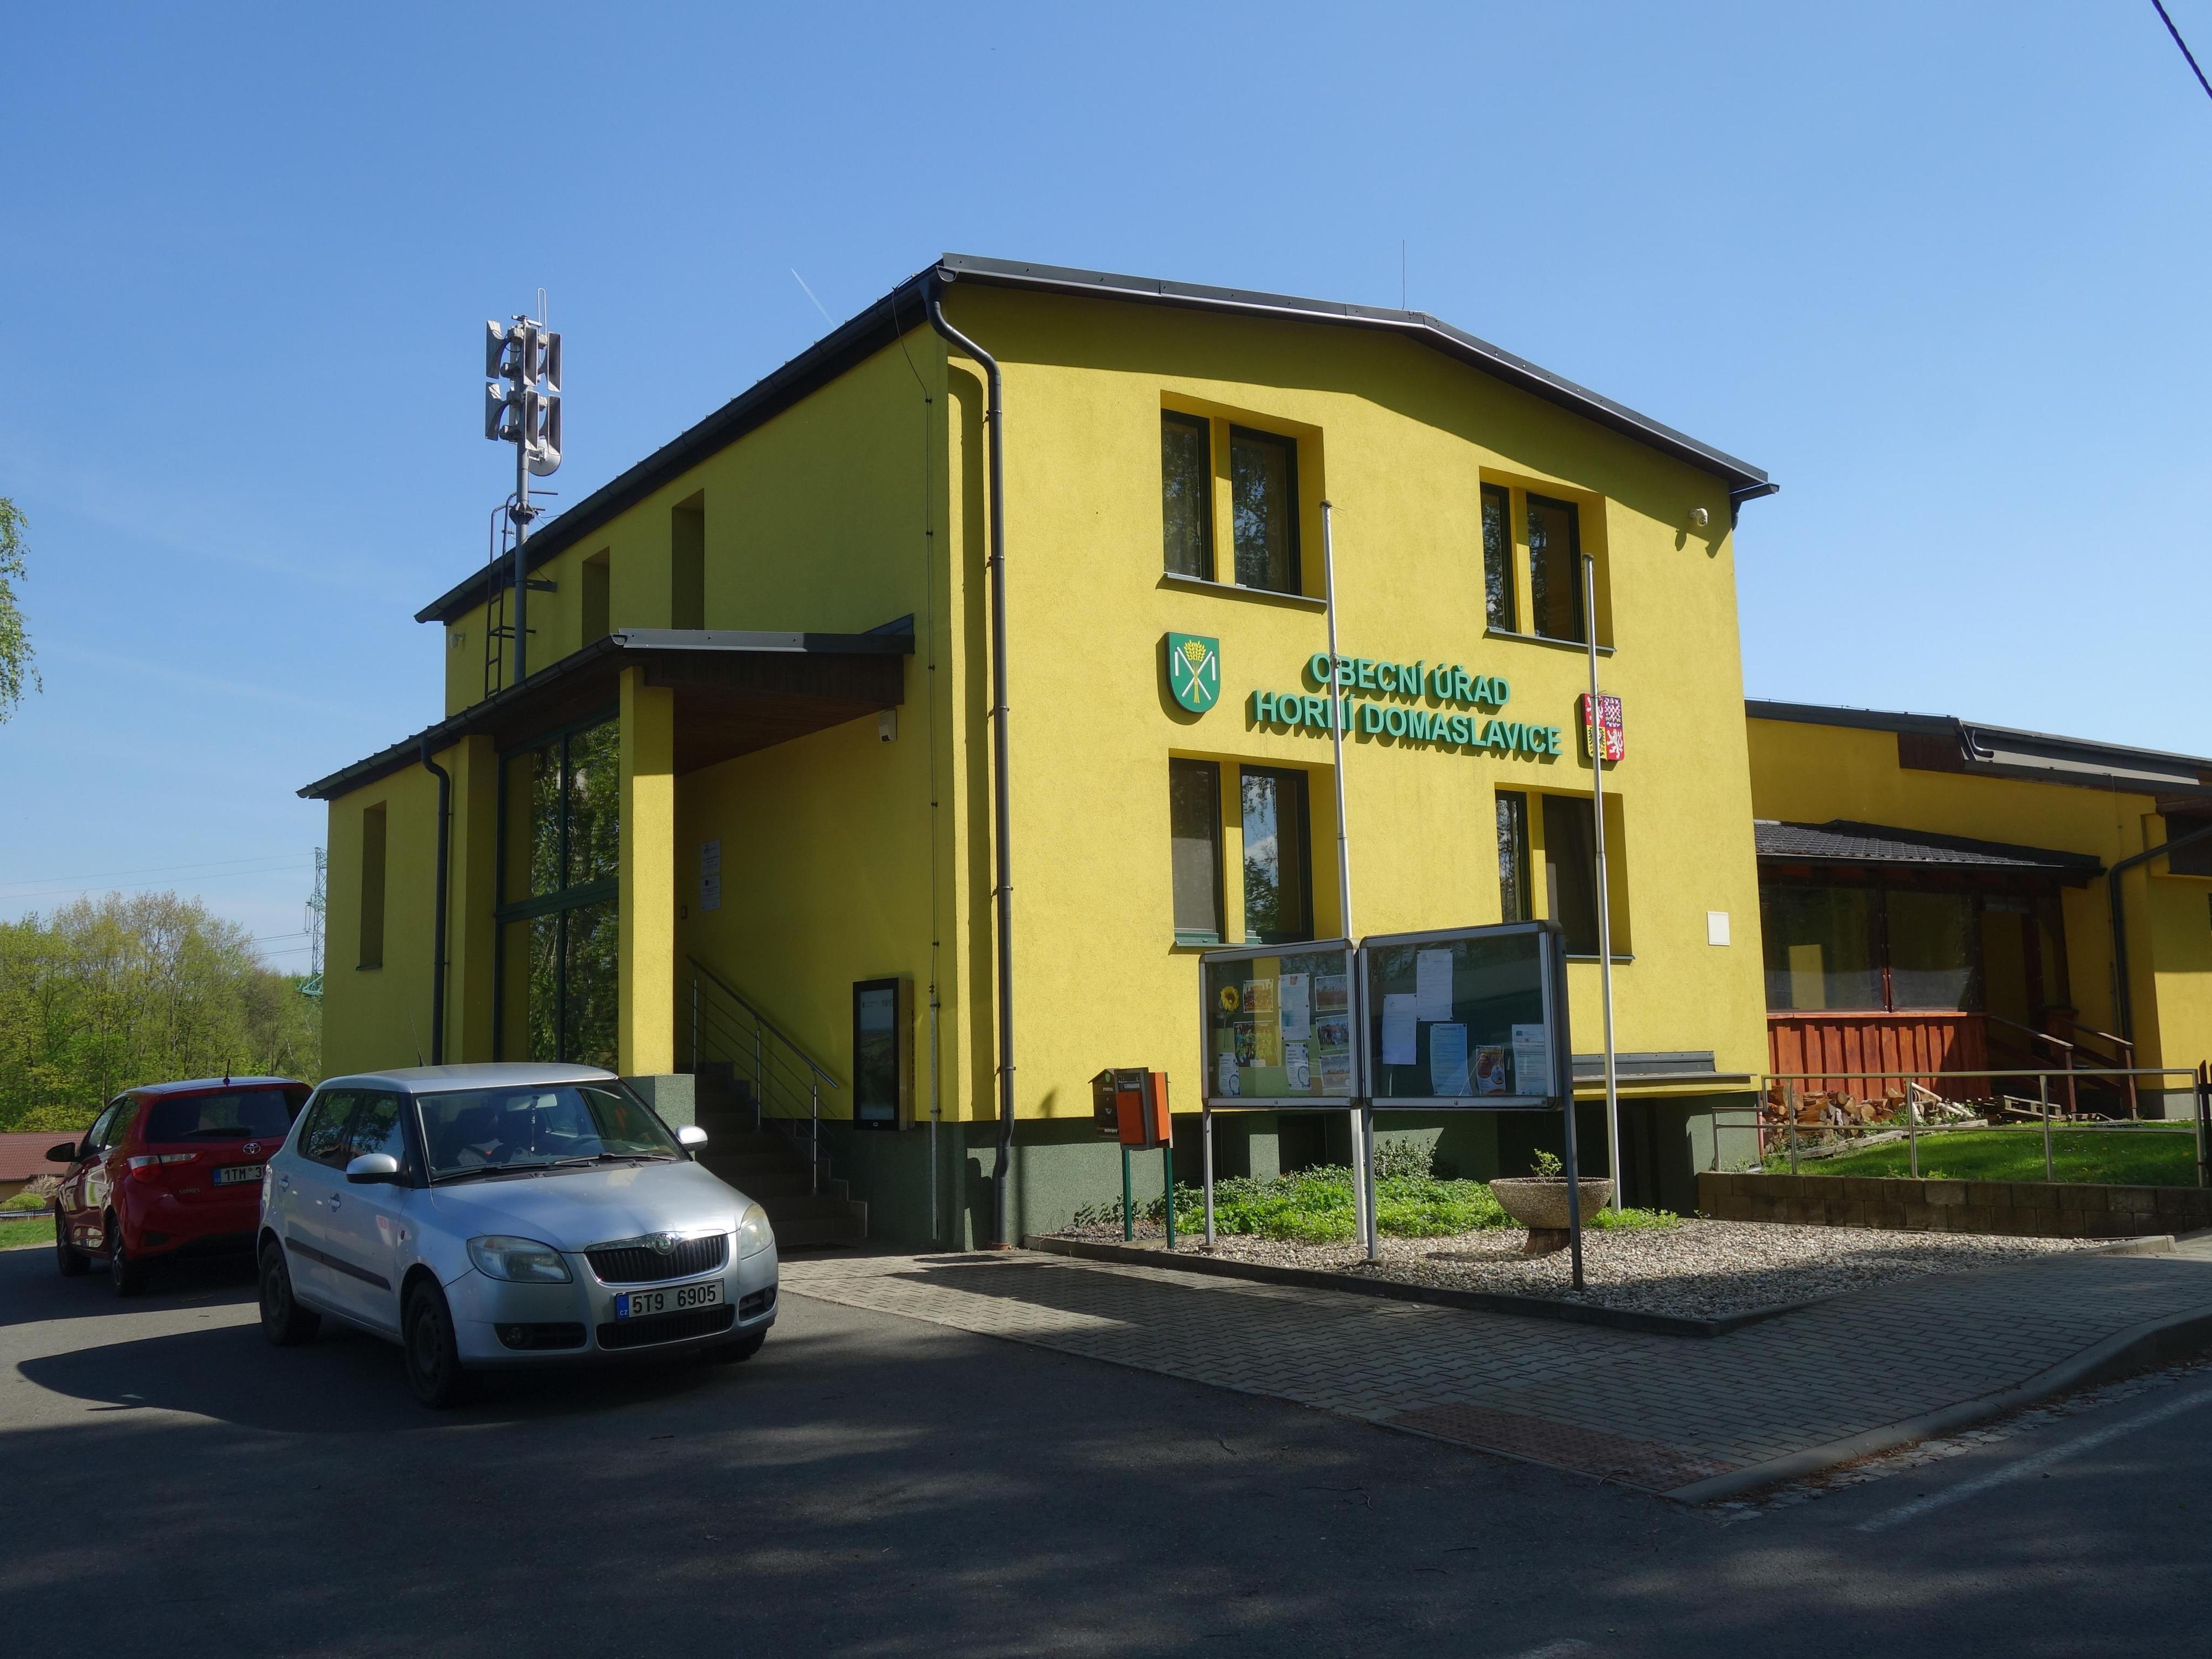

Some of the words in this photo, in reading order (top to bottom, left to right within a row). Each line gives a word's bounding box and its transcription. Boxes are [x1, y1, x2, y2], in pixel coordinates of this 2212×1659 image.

[1311, 653, 1425, 696] OBECNÍ
[1433, 663, 1511, 706] ÚŘAD
[1255, 690, 1355, 730] HORNÍ
[1363, 703, 1563, 755] DOMASLAVICE
[225, 1168, 246, 1181] 1TM
[633, 1293, 664, 1313] 5T9
[677, 1285, 716, 1307] 6905
